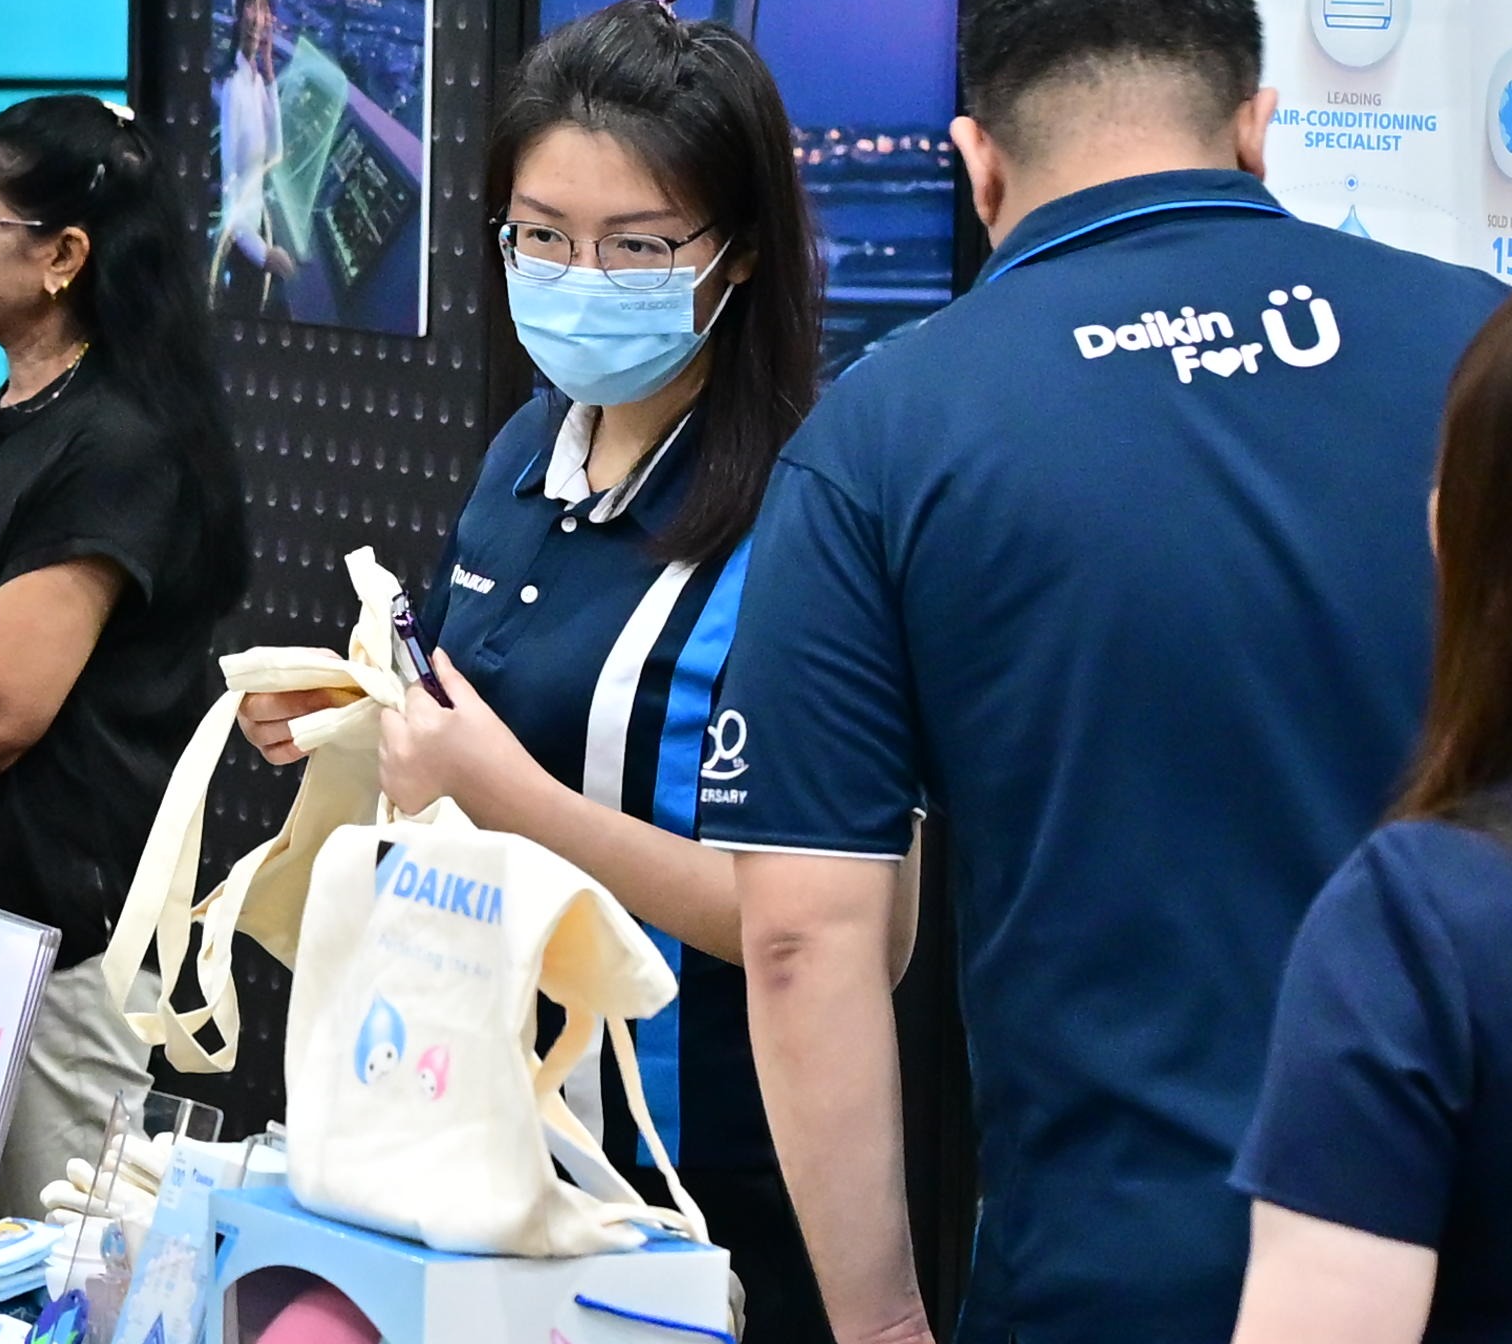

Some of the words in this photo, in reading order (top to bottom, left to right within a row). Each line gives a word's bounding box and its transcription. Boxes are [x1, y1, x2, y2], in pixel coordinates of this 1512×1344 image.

[1327, 91, 1381, 106] LEADING
[1272, 107, 1436, 131] AIR-CONDITIONING
[1304, 131, 1401, 150] SPECIALIST
[1487, 213, 1508, 228] SOLD
[1073, 305, 1234, 361] Daikin
[455, 568, 495, 594] DAIKIN
[701, 788, 747, 804] ERSARY
